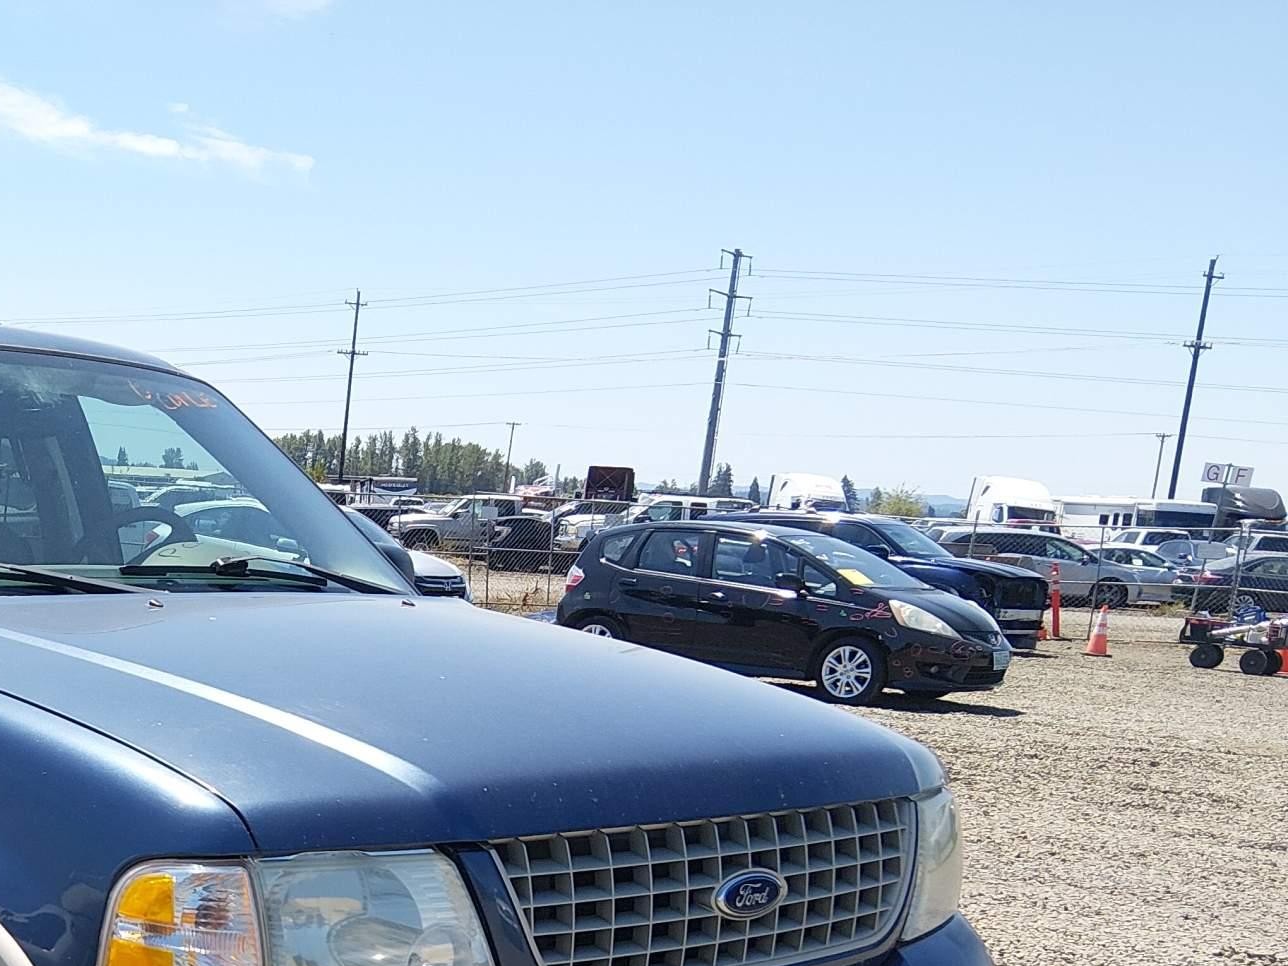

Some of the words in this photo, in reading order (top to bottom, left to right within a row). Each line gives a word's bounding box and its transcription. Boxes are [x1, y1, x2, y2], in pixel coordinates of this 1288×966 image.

[1206, 464, 1219, 481] G
[1235, 468, 1248, 483] F
[735, 883, 768, 907] Ford
